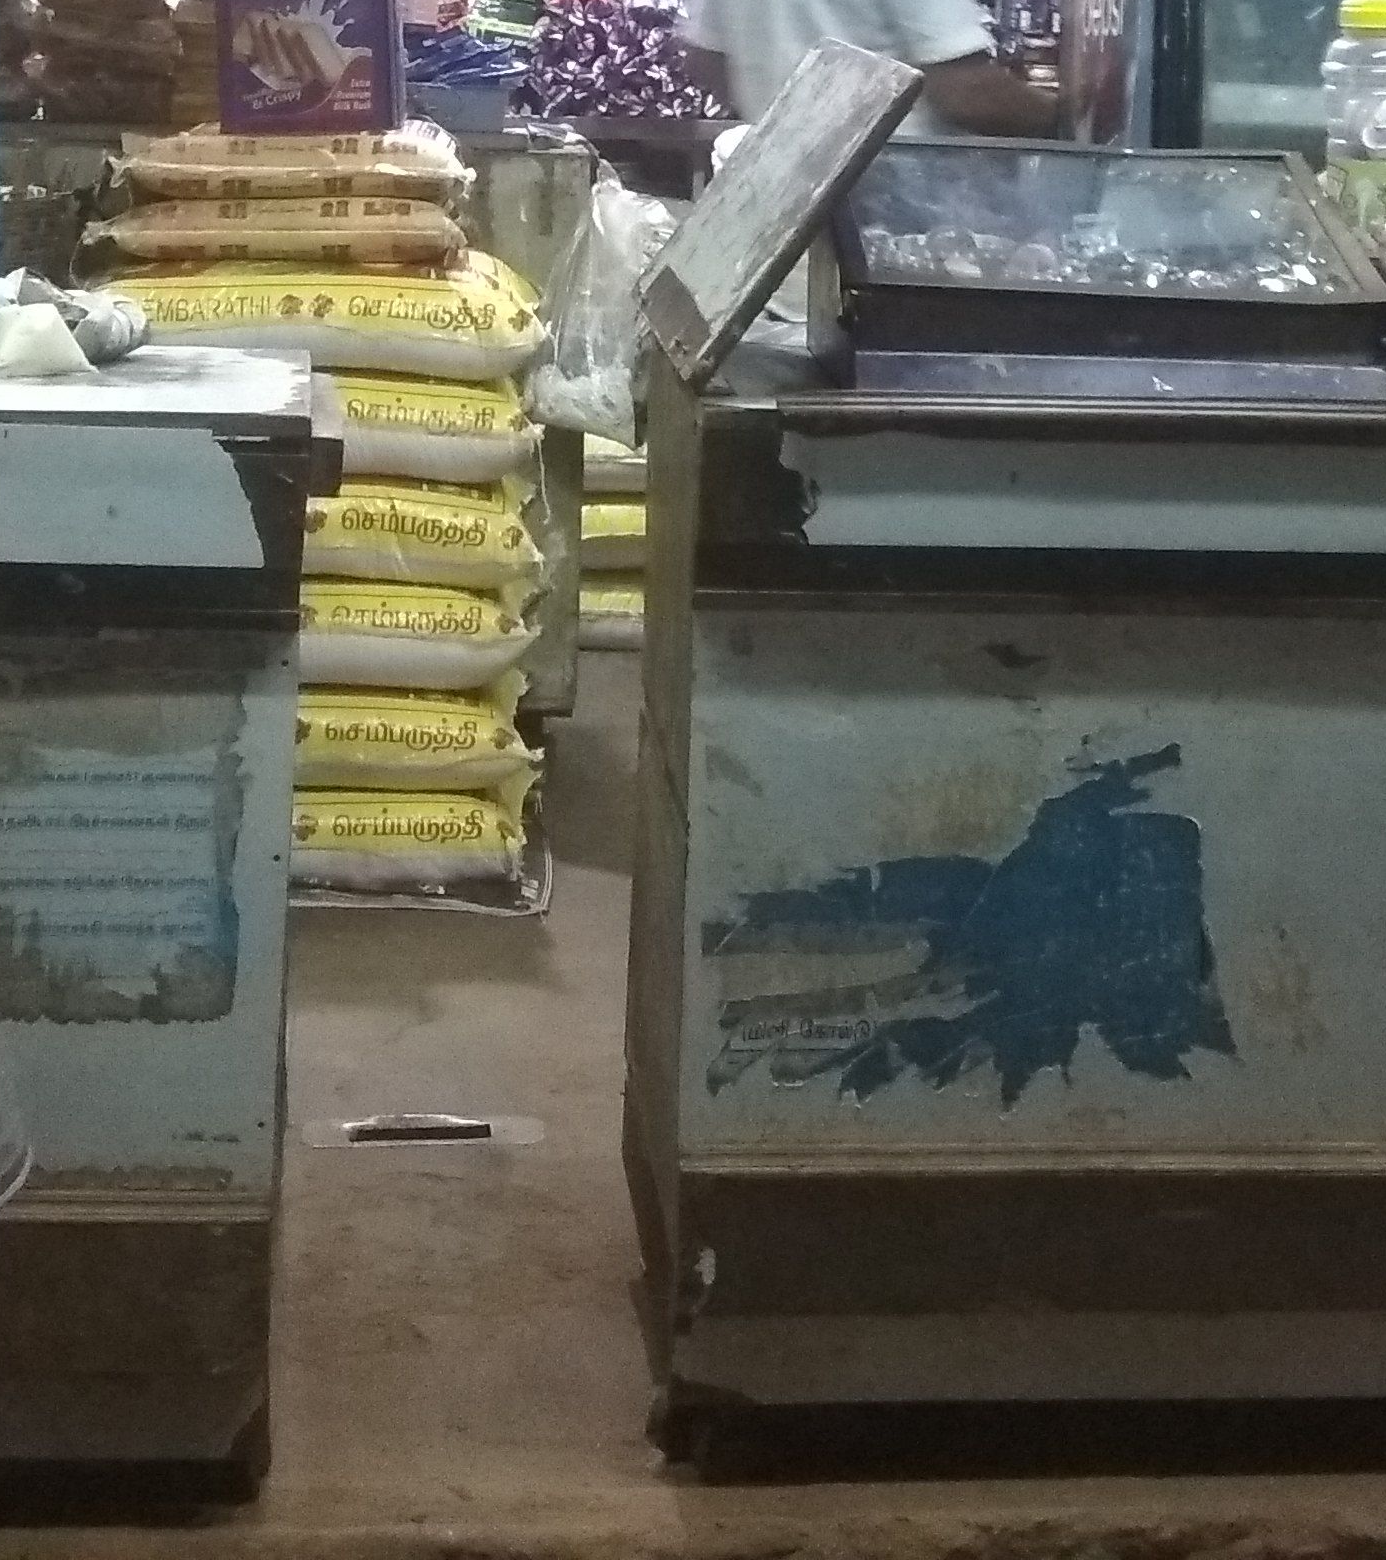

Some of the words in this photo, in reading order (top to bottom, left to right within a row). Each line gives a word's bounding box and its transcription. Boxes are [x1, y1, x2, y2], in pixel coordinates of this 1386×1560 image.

[142, 294, 271, 324] EMBARATHI
[348, 293, 497, 331] செம்பருத்தி
[341, 503, 488, 547] செம்பருத்தி
[325, 717, 478, 752] செம்பருத்தி
[333, 807, 484, 843] செம்பருத்தி
